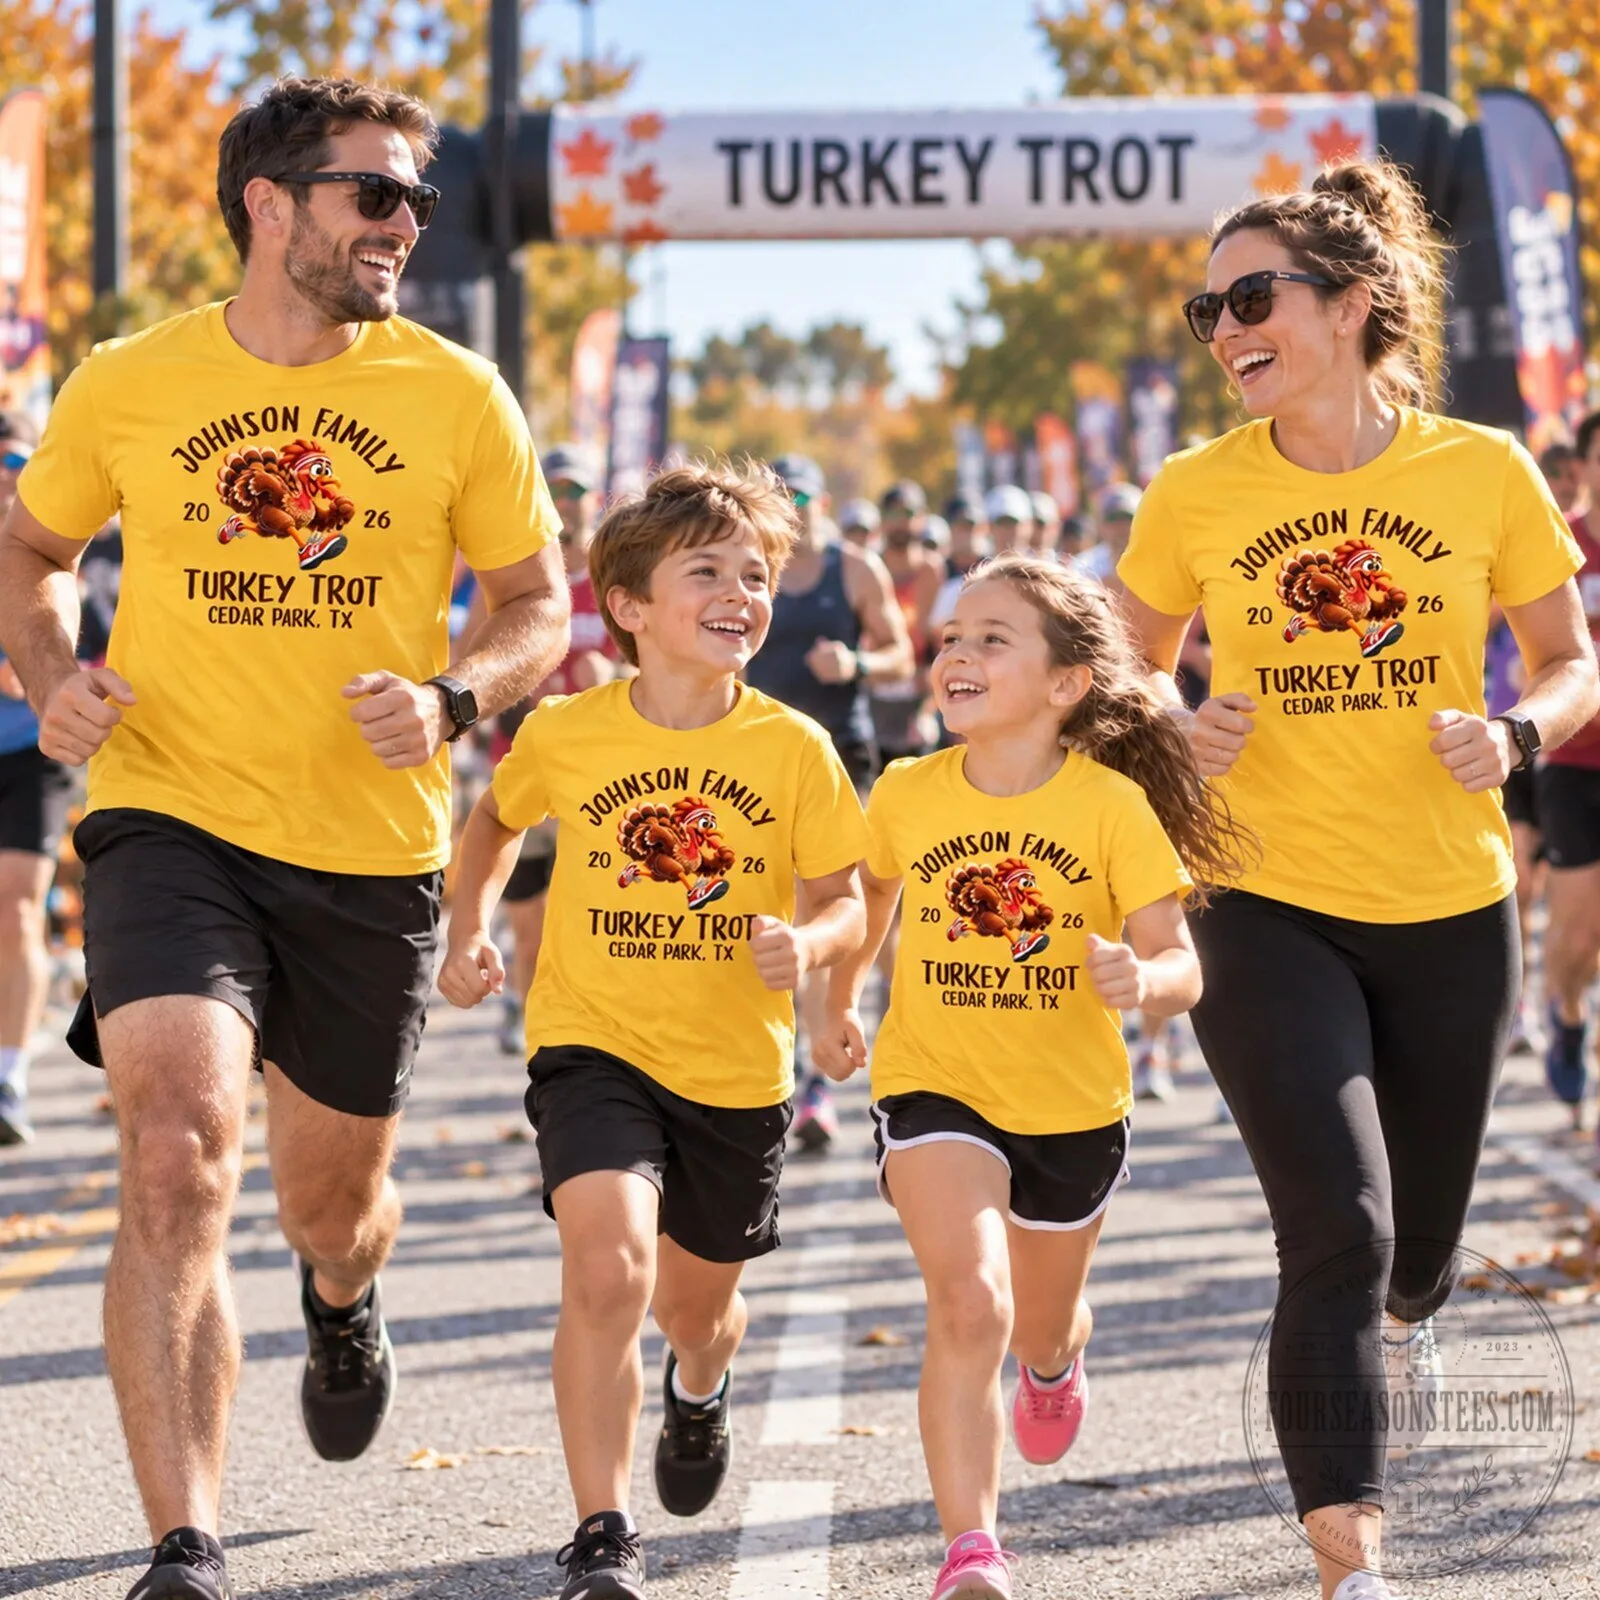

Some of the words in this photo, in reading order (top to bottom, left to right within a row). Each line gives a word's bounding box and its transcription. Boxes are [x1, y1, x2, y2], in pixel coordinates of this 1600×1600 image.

[716, 138, 994, 207] TURKEY
[1016, 136, 1195, 205] TROT
[171, 405, 300, 474] JOHNSON
[312, 407, 405, 474] FAMILY
[183, 502, 210, 523] 20
[363, 509, 391, 529] 26
[1230, 508, 1347, 582] JOHNSON
[1360, 507, 1452, 563] FAMILY
[183, 568, 296, 604] TURKEY
[309, 573, 383, 608] TROT
[208, 605, 264, 626] CEDAR
[329, 609, 353, 629] TX
[1246, 606, 1273, 625] 20
[1417, 594, 1444, 614] 26
[1254, 664, 1361, 696] TURKEY
[1371, 655, 1441, 689] TROT
[1282, 695, 1335, 715] CEDAR
[1395, 690, 1418, 708] TX
[579, 766, 690, 827] JOHNSON
[699, 768, 776, 827] FAMILY
[588, 851, 611, 869] 20
[742, 857, 766, 874] 26
[910, 831, 1011, 884] JOHNSON
[1019, 832, 1093, 885] FAMILY
[587, 908, 685, 940] TURKEY
[695, 912, 758, 941] TROT
[920, 907, 941, 923] 20
[1061, 913, 1084, 929] 26
[608, 941, 656, 960] CEDAR
[713, 944, 734, 961] TX
[921, 959, 1011, 990] TURKEY
[1020, 964, 1080, 991] TROT
[942, 990, 986, 1008] CEDAR
[1039, 994, 1059, 1010] TX
